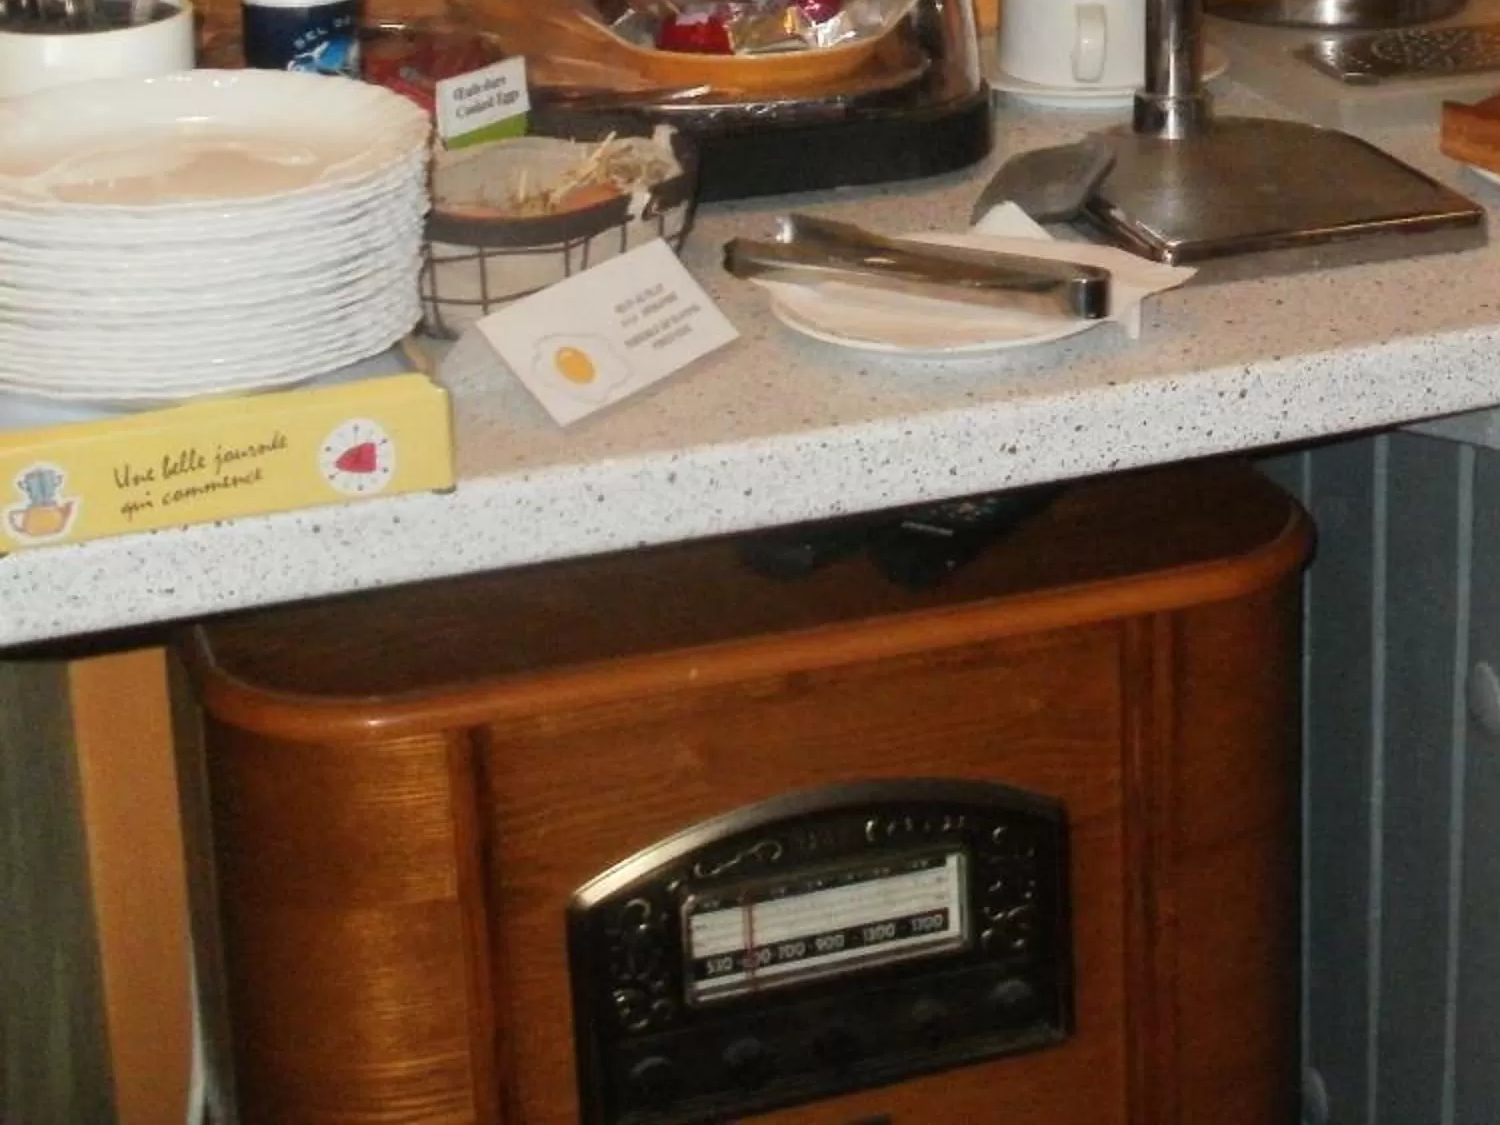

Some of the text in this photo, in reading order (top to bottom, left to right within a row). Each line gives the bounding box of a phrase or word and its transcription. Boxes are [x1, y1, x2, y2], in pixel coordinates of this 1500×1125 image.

[113, 462, 156, 489] Une
[161, 448, 207, 480] belle
[120, 467, 264, 521] qui commence
